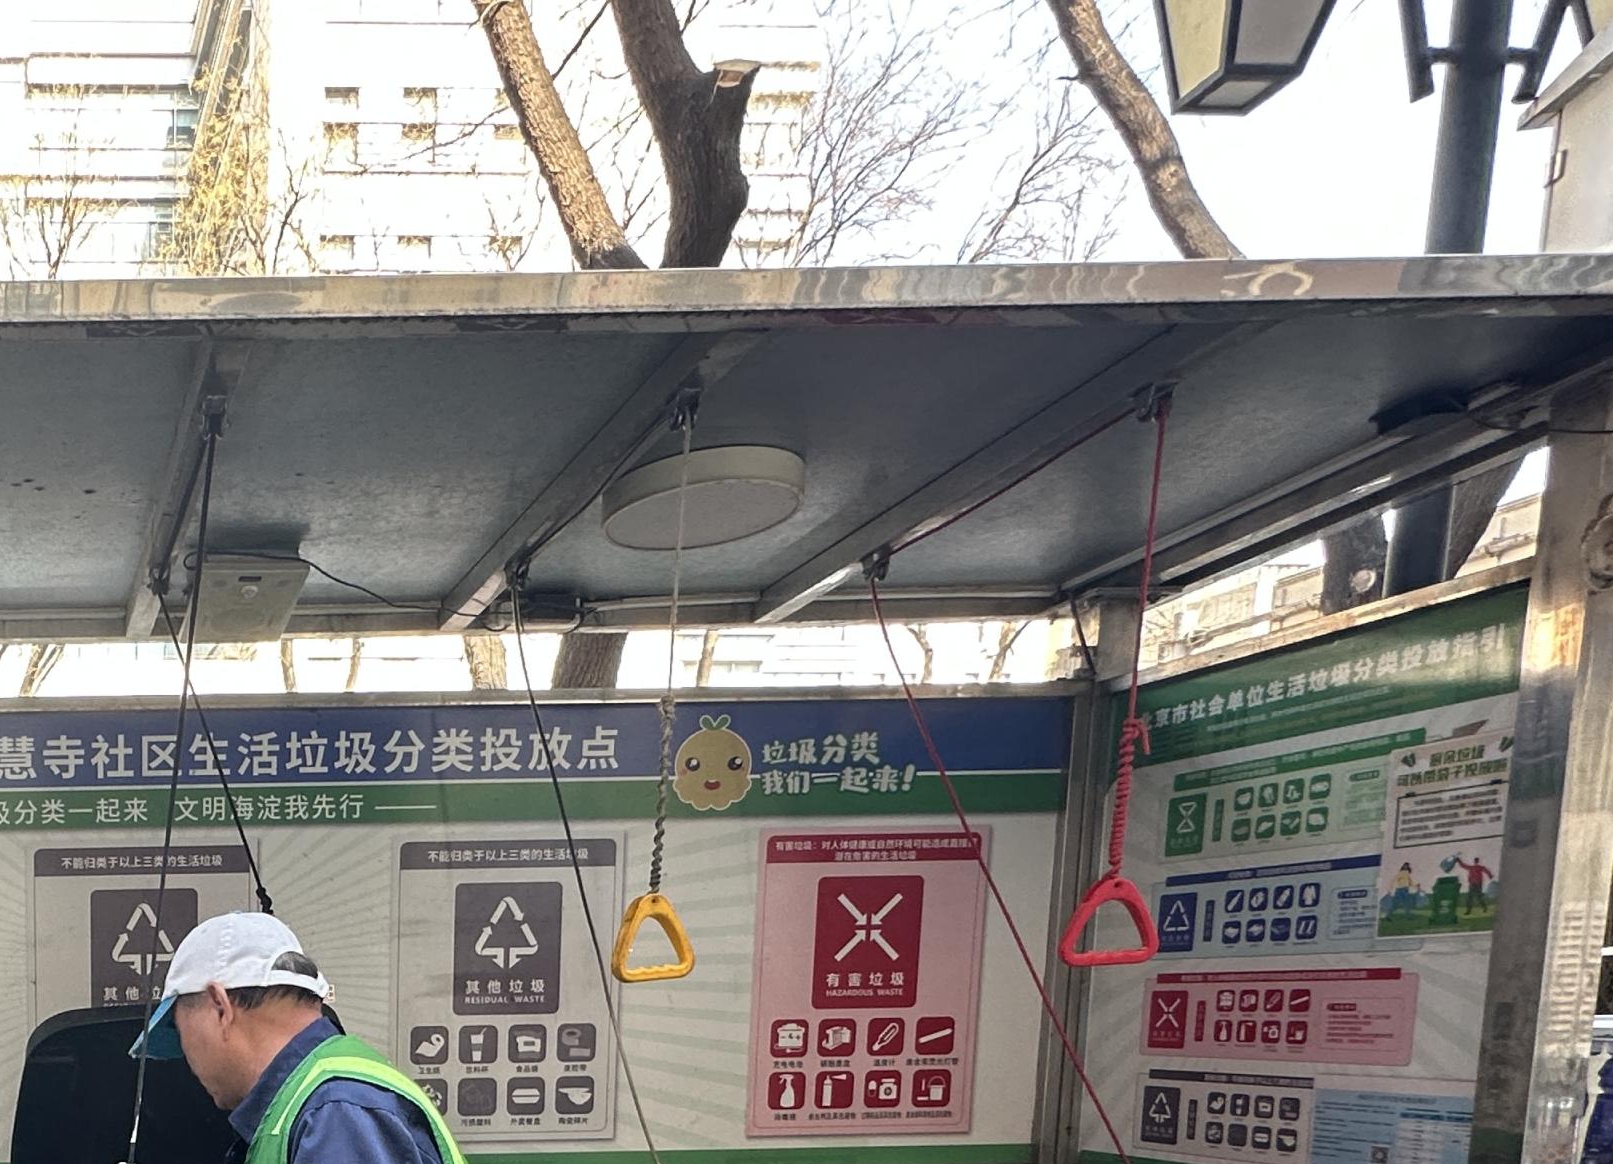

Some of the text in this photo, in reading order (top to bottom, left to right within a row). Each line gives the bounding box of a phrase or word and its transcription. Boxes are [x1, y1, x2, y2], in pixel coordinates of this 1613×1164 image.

[762, 731, 880, 765] 垃圾分类
[174, 794, 364, 822] 文明海淀我先行
[61, 854, 223, 869] 不能归类于以上三类的生活垃圾
[465, 979, 545, 994] 其他垃圾
[826, 972, 904, 988] 有害垃圾
[103, 985, 161, 1001] 其他垃
[515, 995, 544, 1003] WASTE
